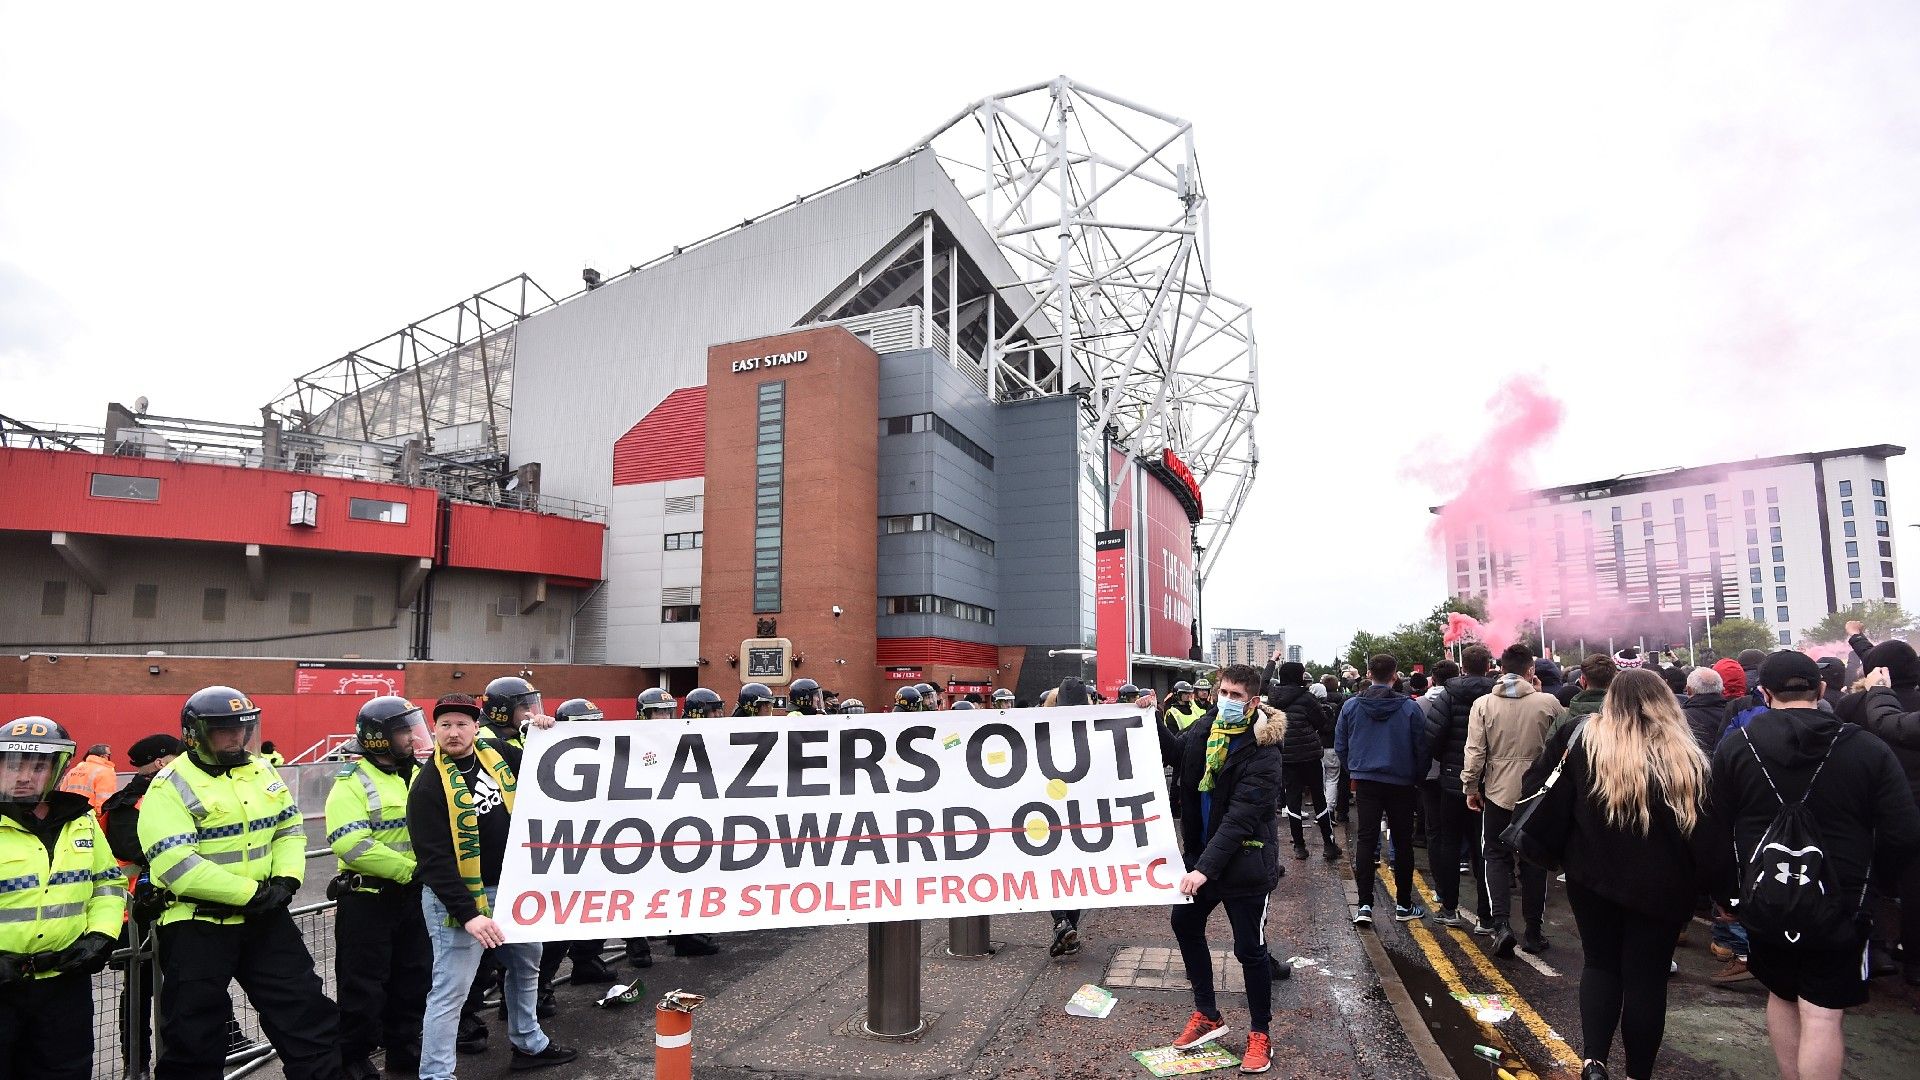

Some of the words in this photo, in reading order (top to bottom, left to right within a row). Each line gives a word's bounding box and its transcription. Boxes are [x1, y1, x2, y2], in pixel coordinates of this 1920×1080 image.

[732, 357, 761, 373] EAST
[764, 350, 808, 367] STAND
[1162, 547, 1179, 593] THE
[229, 698, 254, 712] BD
[490, 711, 509, 722] 329
[11, 723, 48, 736] BD
[8, 743, 40, 752] POLICE
[536, 724, 941, 803] GLAZERS
[965, 715, 1144, 790] OUT
[527, 806, 992, 875] WOODWARD
[1011, 791, 1156, 857] OUT
[511, 889, 635, 926] OVER
[646, 886, 727, 920] £1B
[739, 879, 902, 917] STOLEN
[916, 871, 1039, 905] FROM
[1051, 857, 1174, 898] MUFC
